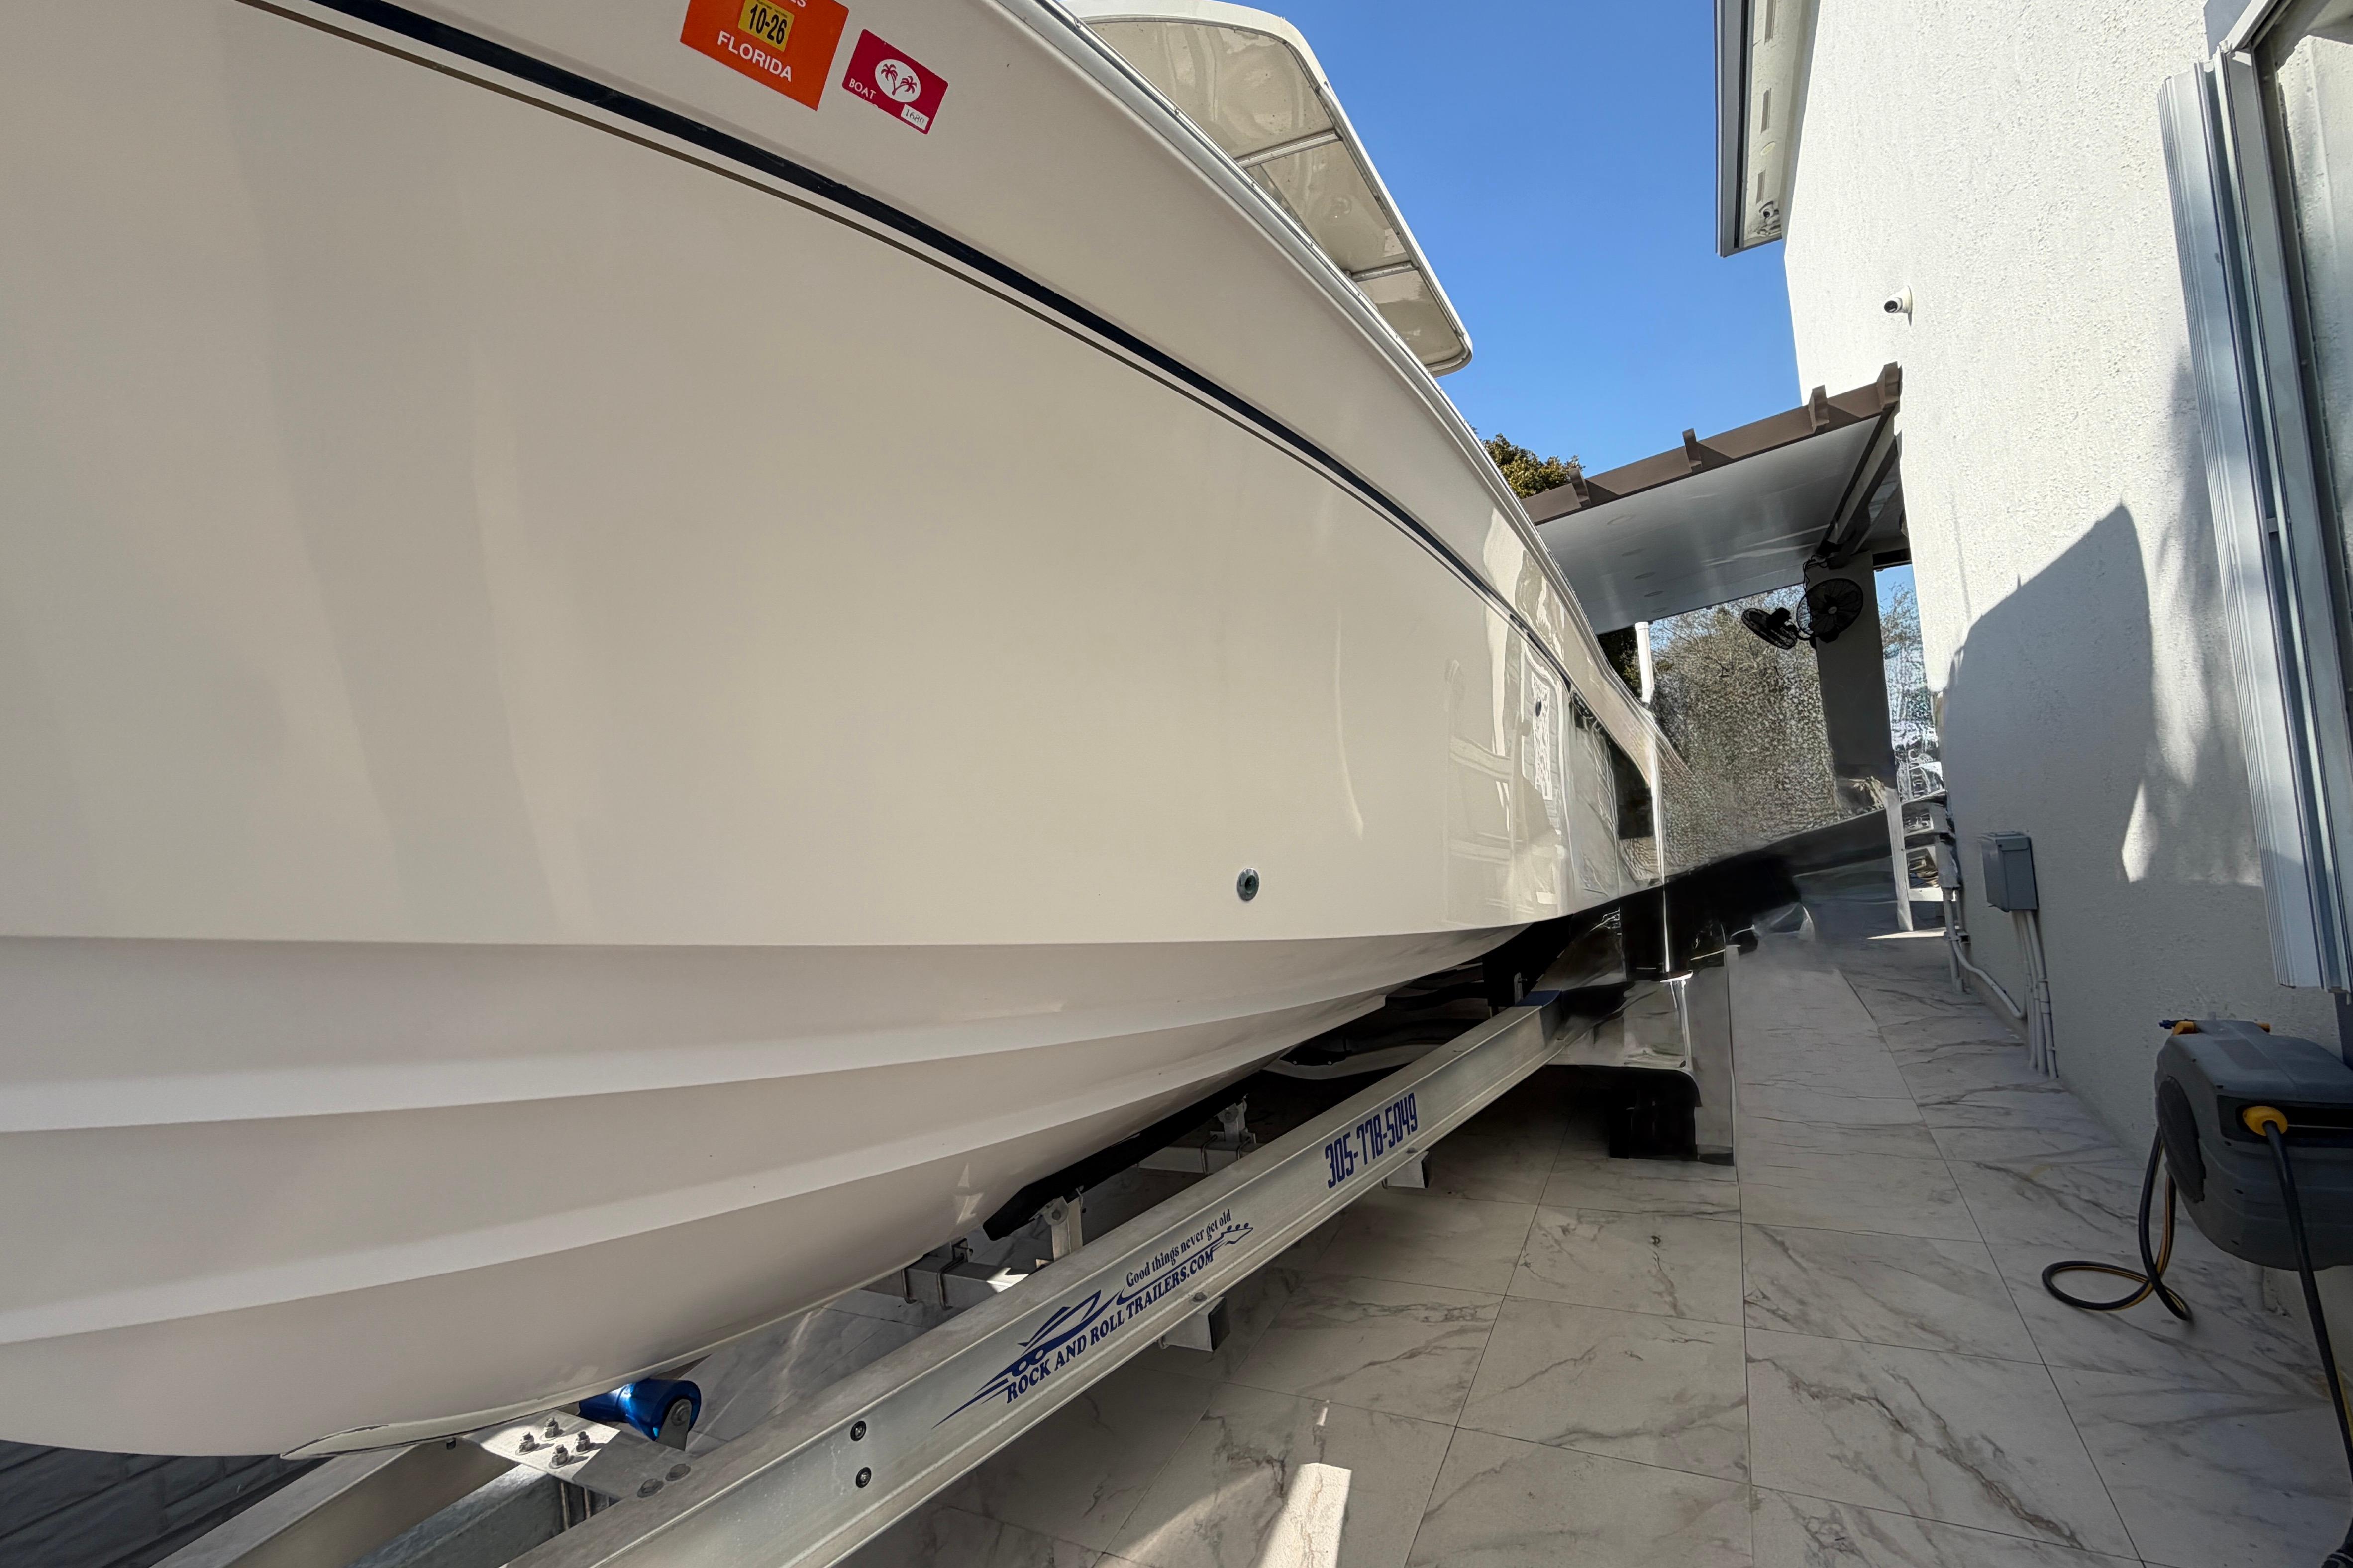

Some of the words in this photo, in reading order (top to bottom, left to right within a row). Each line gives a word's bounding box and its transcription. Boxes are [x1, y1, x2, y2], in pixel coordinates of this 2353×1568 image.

[717, 30, 791, 82] FLORIDA
[749, 4, 787, 44] 10-26
[849, 78, 876, 99] BOAT
[1325, 1092, 1418, 1189] 305-778-5049
[1126, 1262, 1151, 1287] Good
[1152, 1246, 1179, 1272] things
[1181, 1229, 1205, 1253] never
[1206, 1220, 1218, 1241] get
[1219, 1209, 1231, 1226] old
[1007, 1359, 1051, 1403] ROCK
[1054, 1335, 1087, 1371] AND
[1090, 1310, 1125, 1346] ROLL
[1126, 1248, 1214, 1320] TRAILERS.COM
